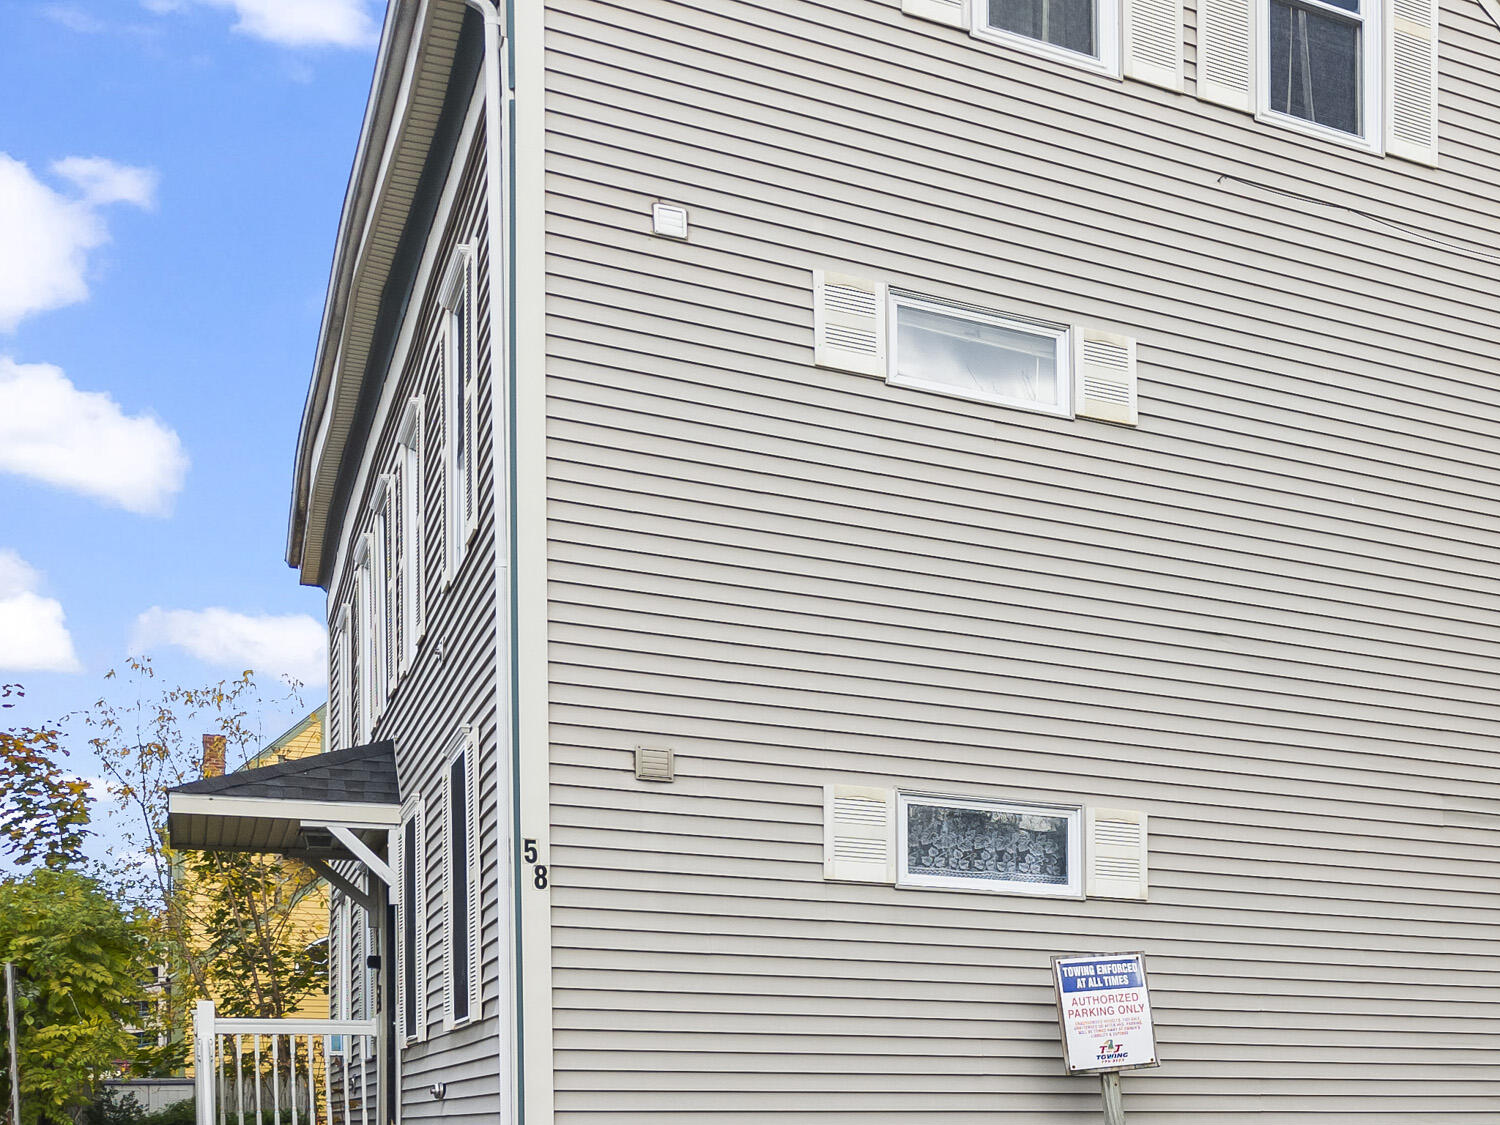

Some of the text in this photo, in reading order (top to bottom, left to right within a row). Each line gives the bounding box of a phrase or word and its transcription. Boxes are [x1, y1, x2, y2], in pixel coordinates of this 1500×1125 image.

[1062, 962, 1138, 978] TOWING ENFORCED
[1076, 975, 1129, 989] AT ALL TIMES
[1071, 992, 1139, 1007] AUTHORIZED
[1067, 1003, 1145, 1019] PARKING ONLY
[1096, 1052, 1129, 1060] TOWING
